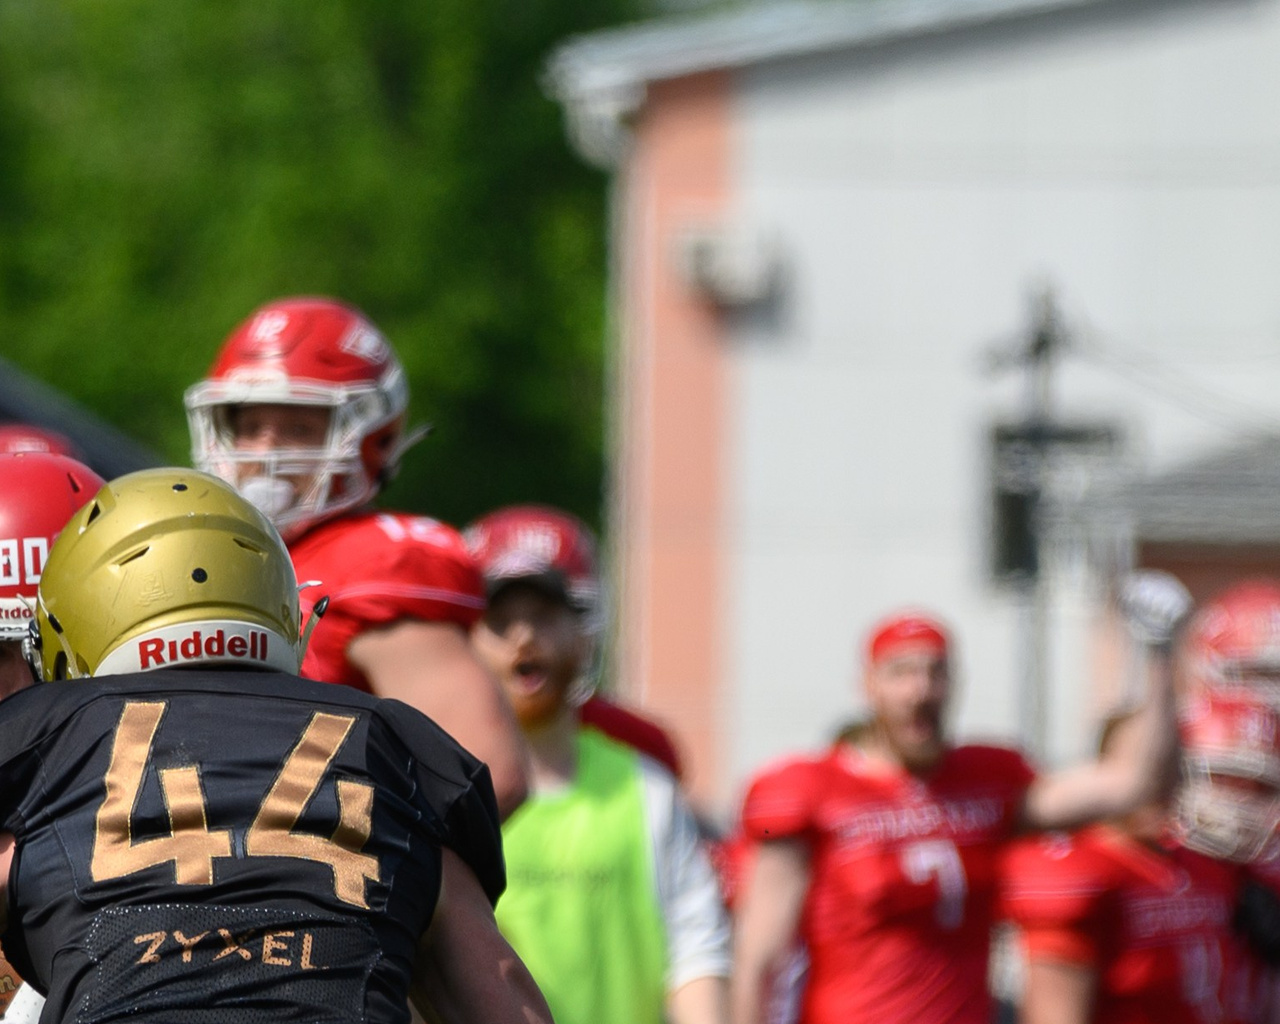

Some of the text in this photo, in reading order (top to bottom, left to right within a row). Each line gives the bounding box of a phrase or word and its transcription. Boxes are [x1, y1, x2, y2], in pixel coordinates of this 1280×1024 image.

[139, 629, 268, 670] Riddell
[90, 701, 381, 910] 44
[901, 838, 968, 931] 7
[133, 927, 331, 971] ZYXEL
